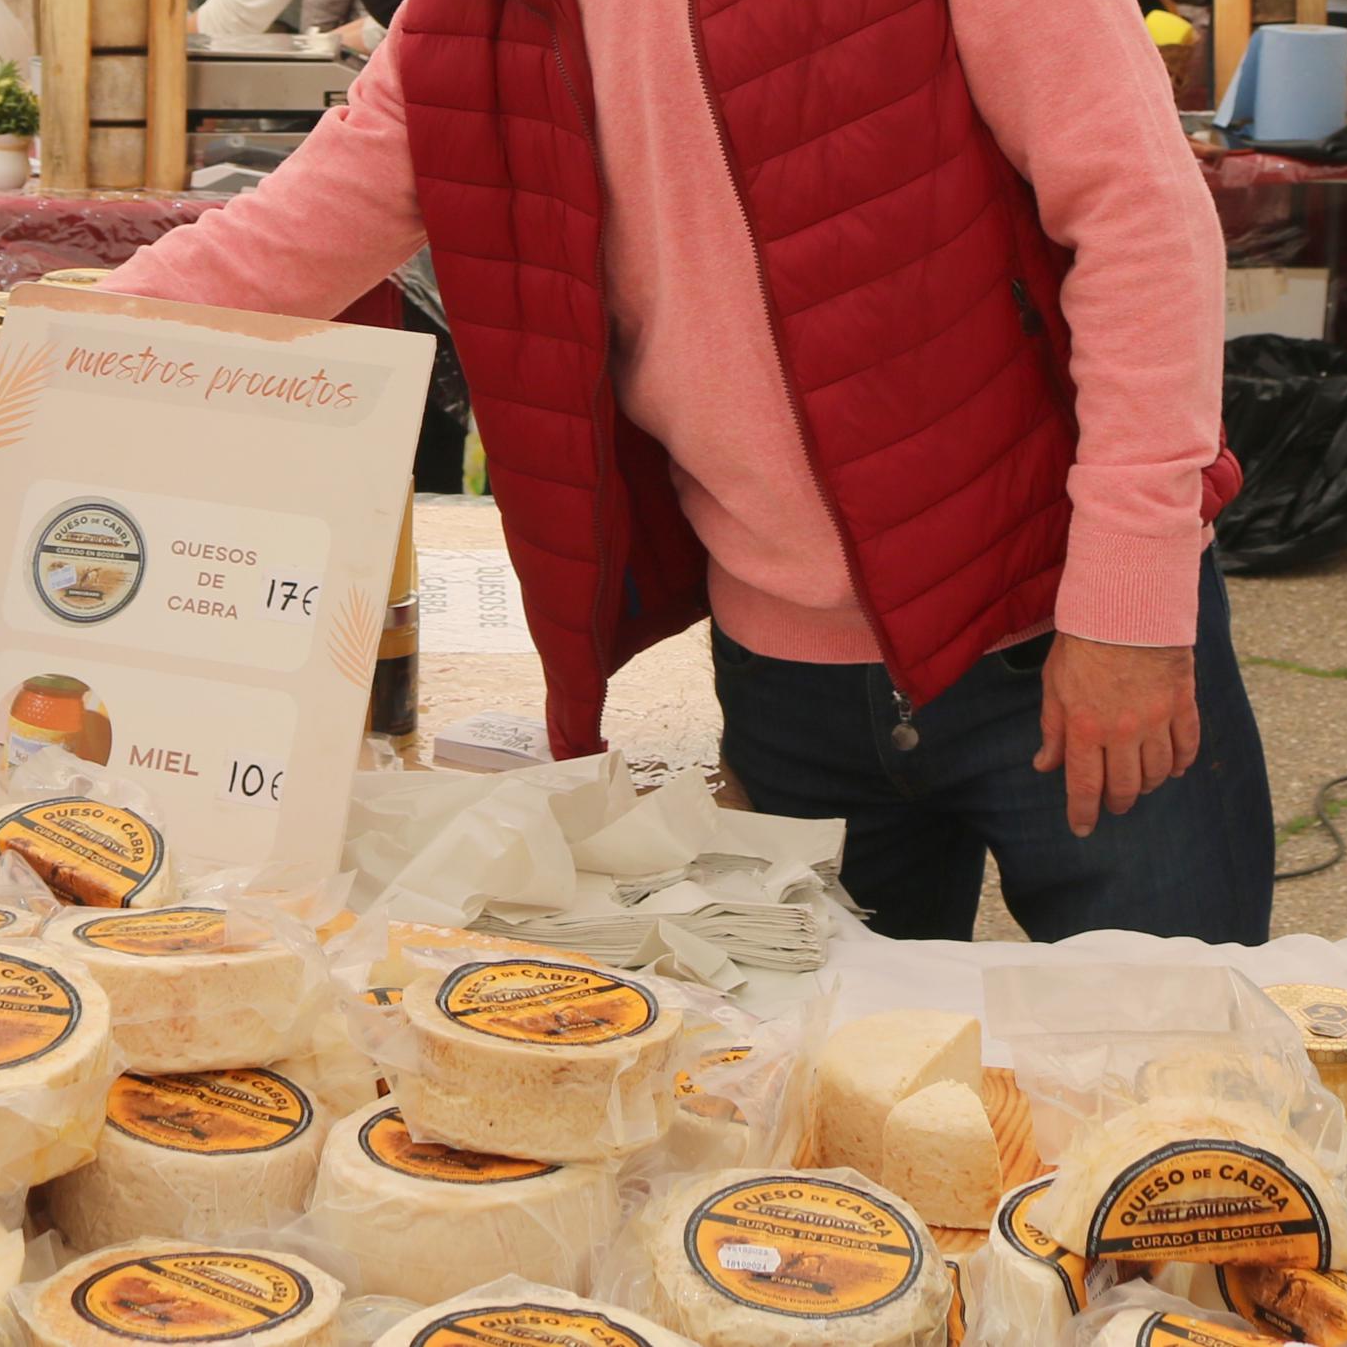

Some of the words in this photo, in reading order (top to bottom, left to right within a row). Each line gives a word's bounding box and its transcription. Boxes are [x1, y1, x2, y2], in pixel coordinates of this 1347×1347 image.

[65, 345, 201, 388] nuestros
[54, 515, 89, 541] QUESO
[102, 518, 131, 548] CABRA
[170, 538, 259, 568] QUESOS
[198, 571, 226, 591] DE
[167, 594, 240, 621] CABRA
[128, 745, 201, 777] MIEL
[33, 824, 73, 849] CURADO
[71, 843, 87, 856] EN
[85, 850, 124, 874] BODEGA
[42, 807, 106, 821] QUESO
[106, 814, 121, 826] DE
[120, 822, 146, 864] CABRA
[1, 969, 55, 1002] CABRA
[459, 973, 498, 1005] QUESO
[501, 970, 519, 978] DE
[520, 968, 591, 985] CABRA
[220, 1102, 271, 1121] BODEGA
[251, 1079, 291, 1112] CABRA
[1120, 1168, 1186, 1227] QUESO
[1192, 1168, 1212, 1179] DE
[1218, 1163, 1291, 1214] CABRA
[733, 1189, 804, 1212] QUESO
[810, 1194, 829, 1203] DE
[835, 1197, 894, 1239] CABRA
[735, 1217, 796, 1236] CURADO
[798, 1230, 819, 1242] EN
[820, 1232, 881, 1252] BODEGA
[1023, 1222, 1051, 1247] QU
[1131, 1232, 1195, 1250] CURADO
[1197, 1229, 1218, 1244] EN
[1220, 1222, 1285, 1242] BODEGA
[173, 1259, 249, 1269] QUESO
[480, 1316, 562, 1330] QUESO
